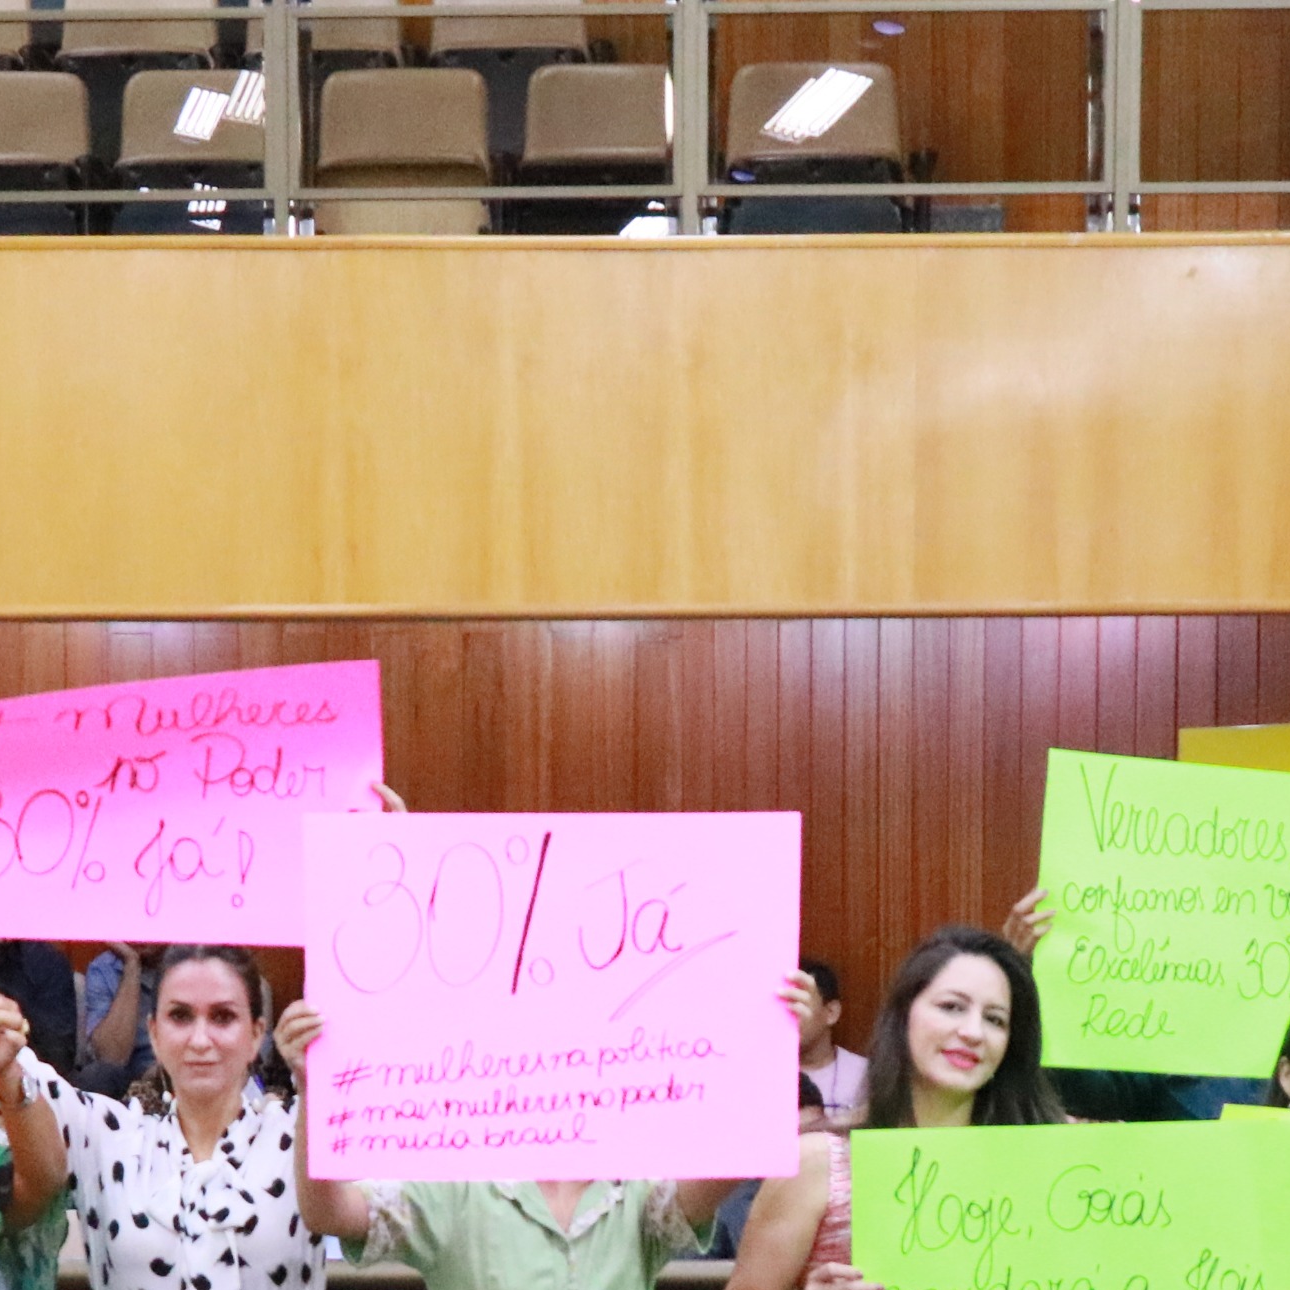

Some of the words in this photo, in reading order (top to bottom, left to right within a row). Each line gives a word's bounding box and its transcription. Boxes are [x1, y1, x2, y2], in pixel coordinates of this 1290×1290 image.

[99, 751, 167, 794] no
[191, 732, 326, 800] Poder
[333, 831, 555, 995] 30%
[578, 858, 688, 970] Já
[1064, 875, 1206, 954] confiamos
[1213, 885, 1256, 915] em
[1081, 993, 1177, 1040] Rede
[1047, 1162, 1173, 1233] Goiás
